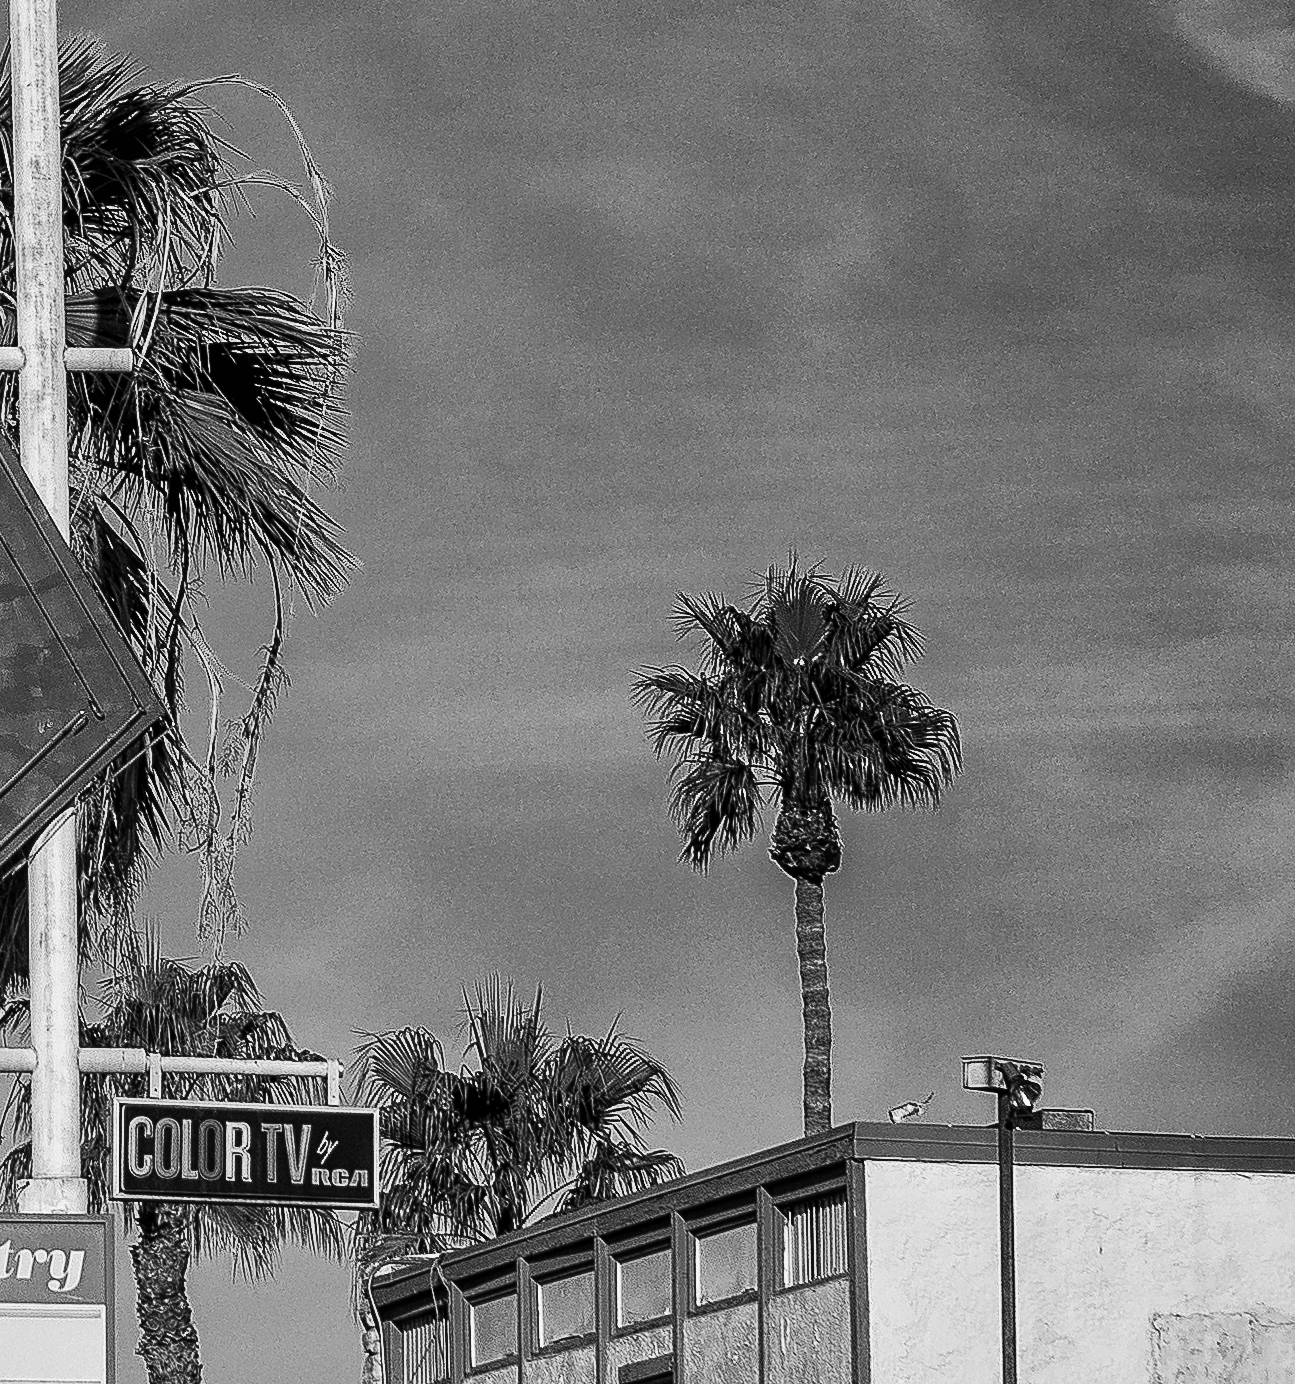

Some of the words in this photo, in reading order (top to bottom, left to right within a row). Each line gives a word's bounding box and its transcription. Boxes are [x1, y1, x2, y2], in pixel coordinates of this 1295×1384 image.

[127, 1115, 252, 1183] COLOR
[261, 1123, 312, 1185] TV
[316, 1130, 339, 1165] by
[312, 1167, 369, 1188] RCA
